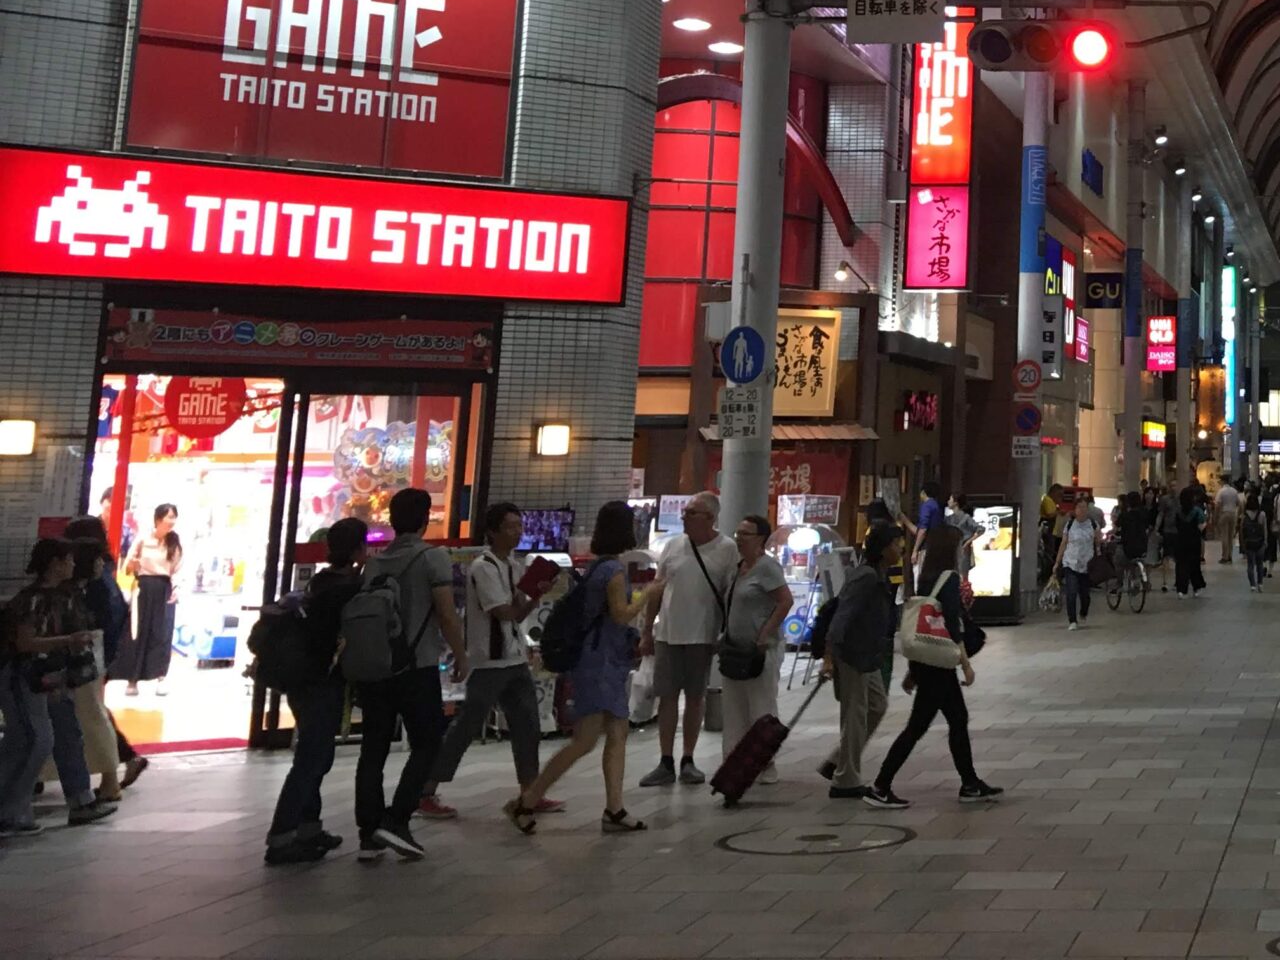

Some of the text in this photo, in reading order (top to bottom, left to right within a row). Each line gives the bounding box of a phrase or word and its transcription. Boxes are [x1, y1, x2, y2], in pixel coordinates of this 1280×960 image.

[219, 72, 438, 123] TAITO STATION
[184, 195, 591, 275] TAITO STATION
[928, 195, 961, 283] さかな市場
[1088, 282, 1120, 300] GU
[1021, 368, 1036, 384] 20
[178, 393, 228, 415] GAME
[178, 416, 226, 426] TAITO STATION
